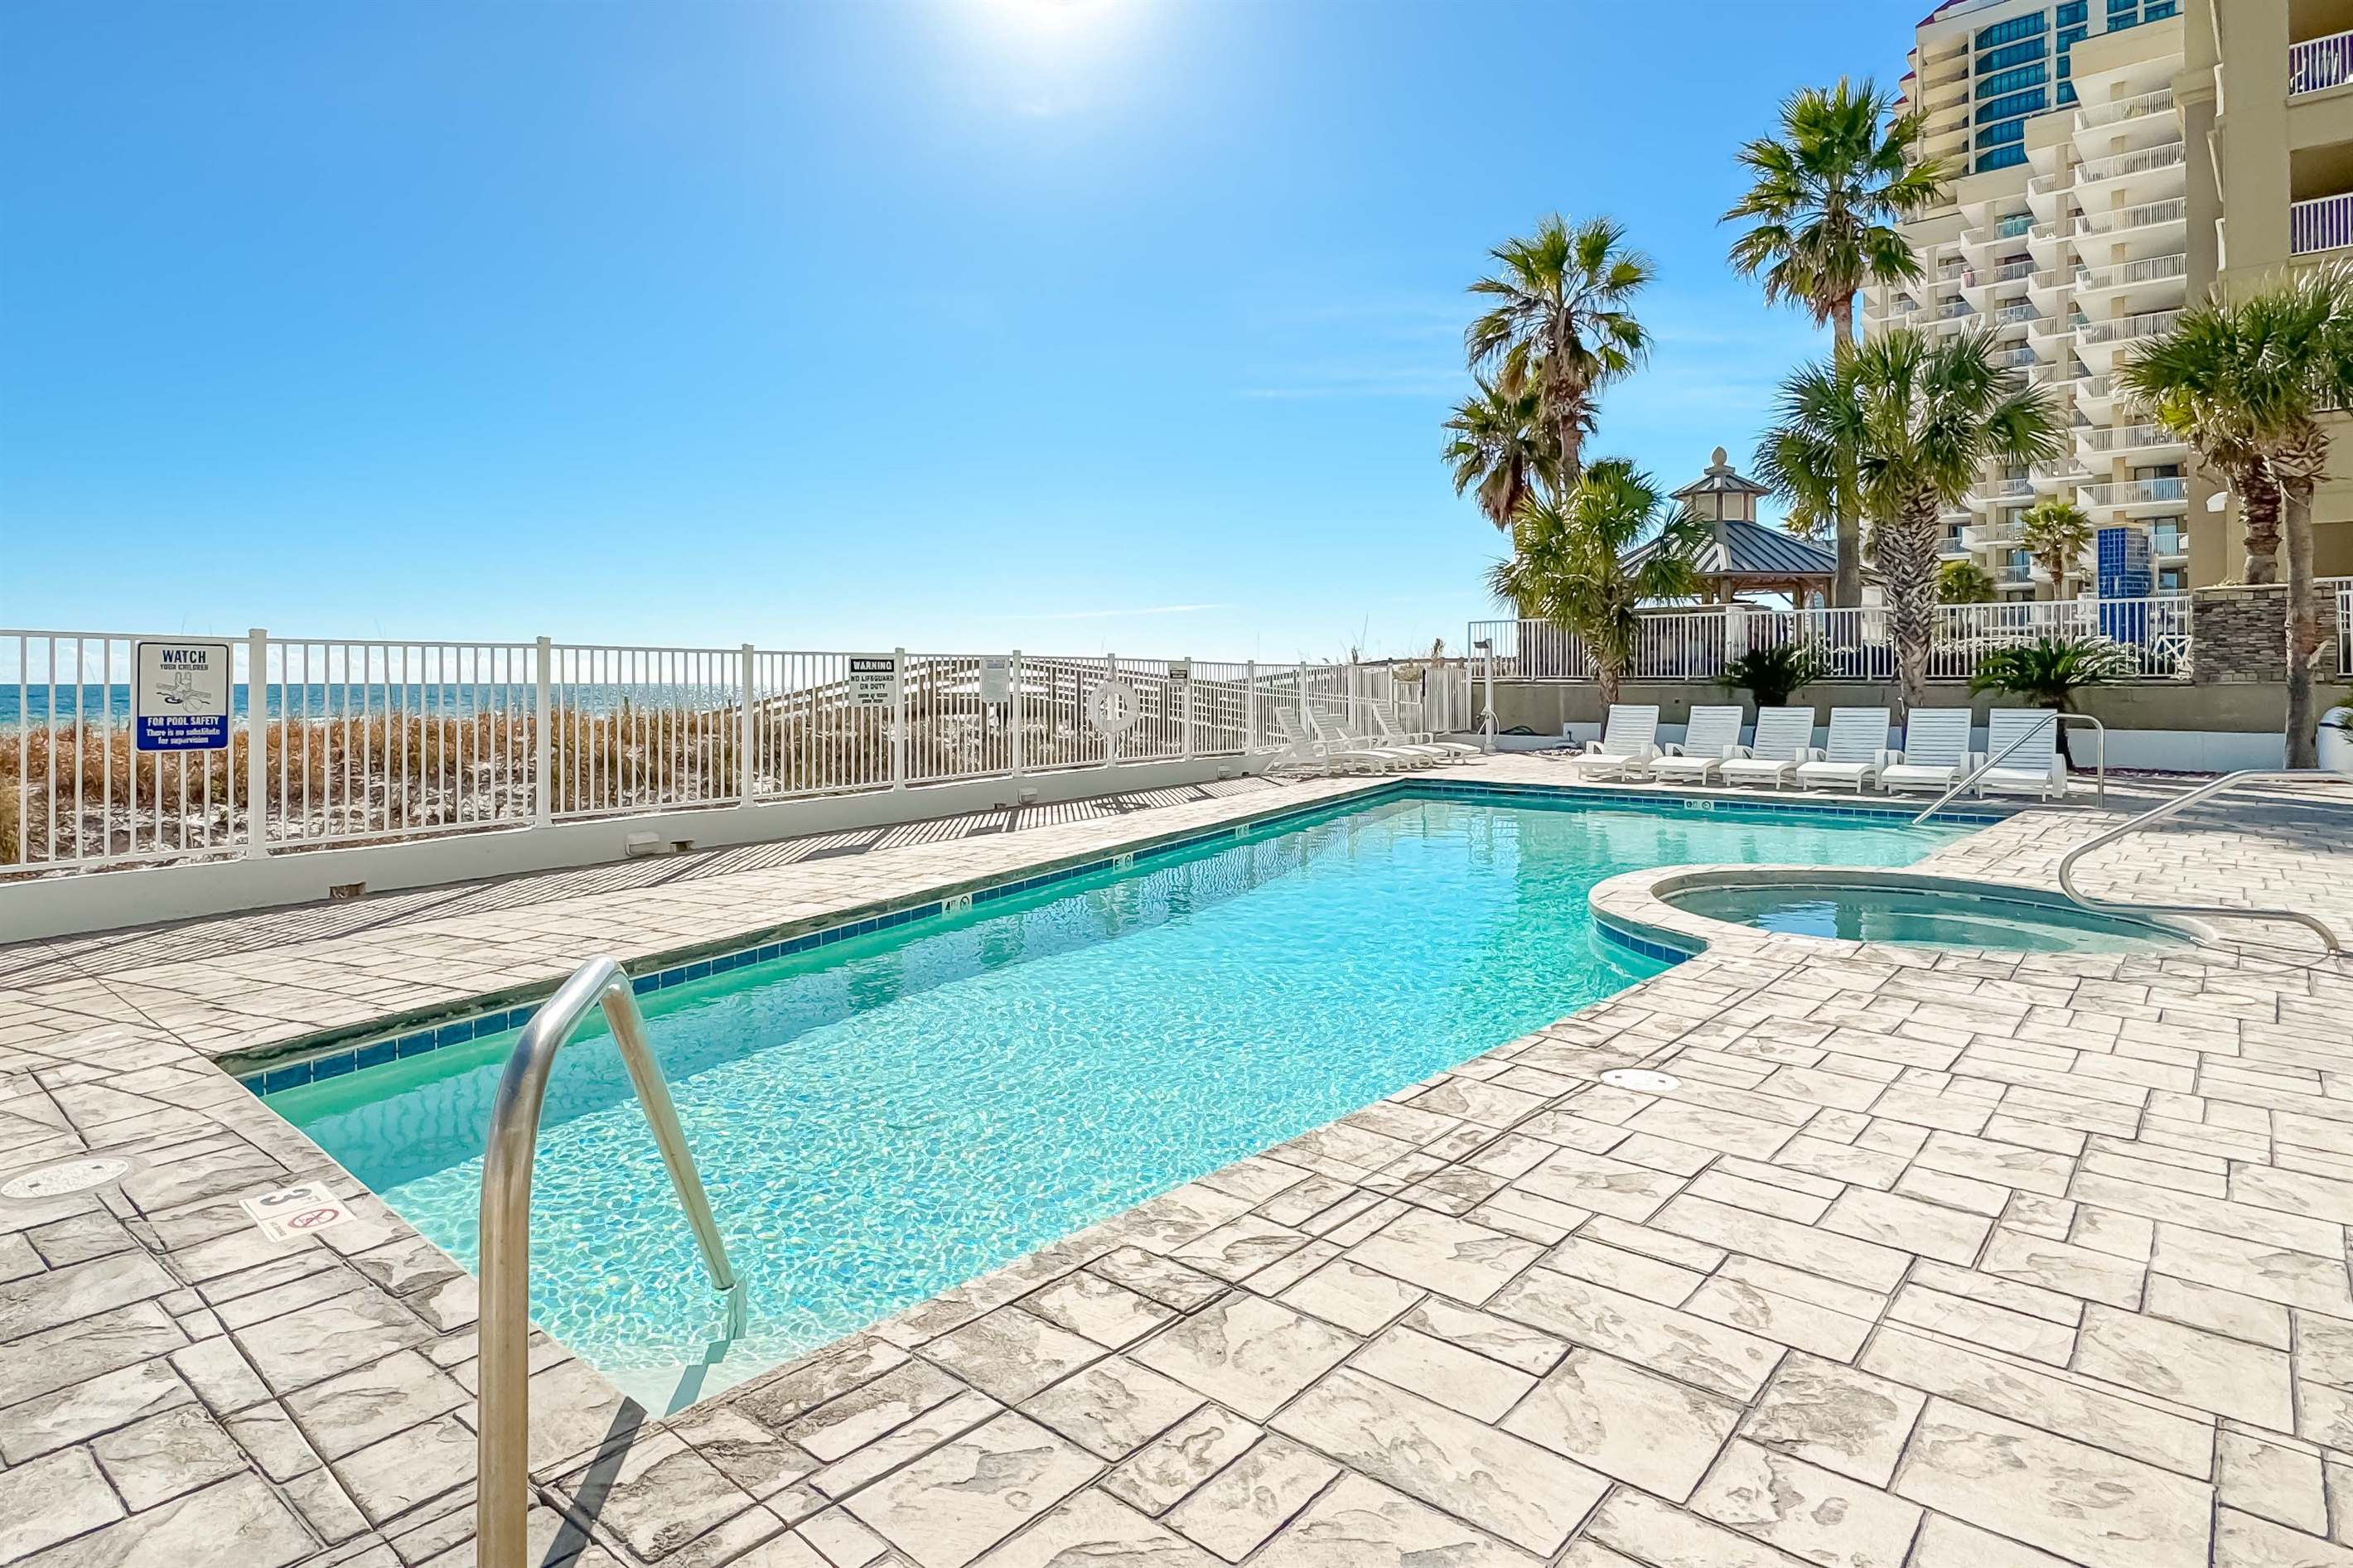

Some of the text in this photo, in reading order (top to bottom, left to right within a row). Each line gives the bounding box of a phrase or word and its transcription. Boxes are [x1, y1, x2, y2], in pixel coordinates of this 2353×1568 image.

[162, 650, 205, 663] WATCH
[853, 661, 892, 670] WARNING
[147, 716, 219, 726] FOR POOL SAFETY
[259, 1188, 312, 1206] 3
